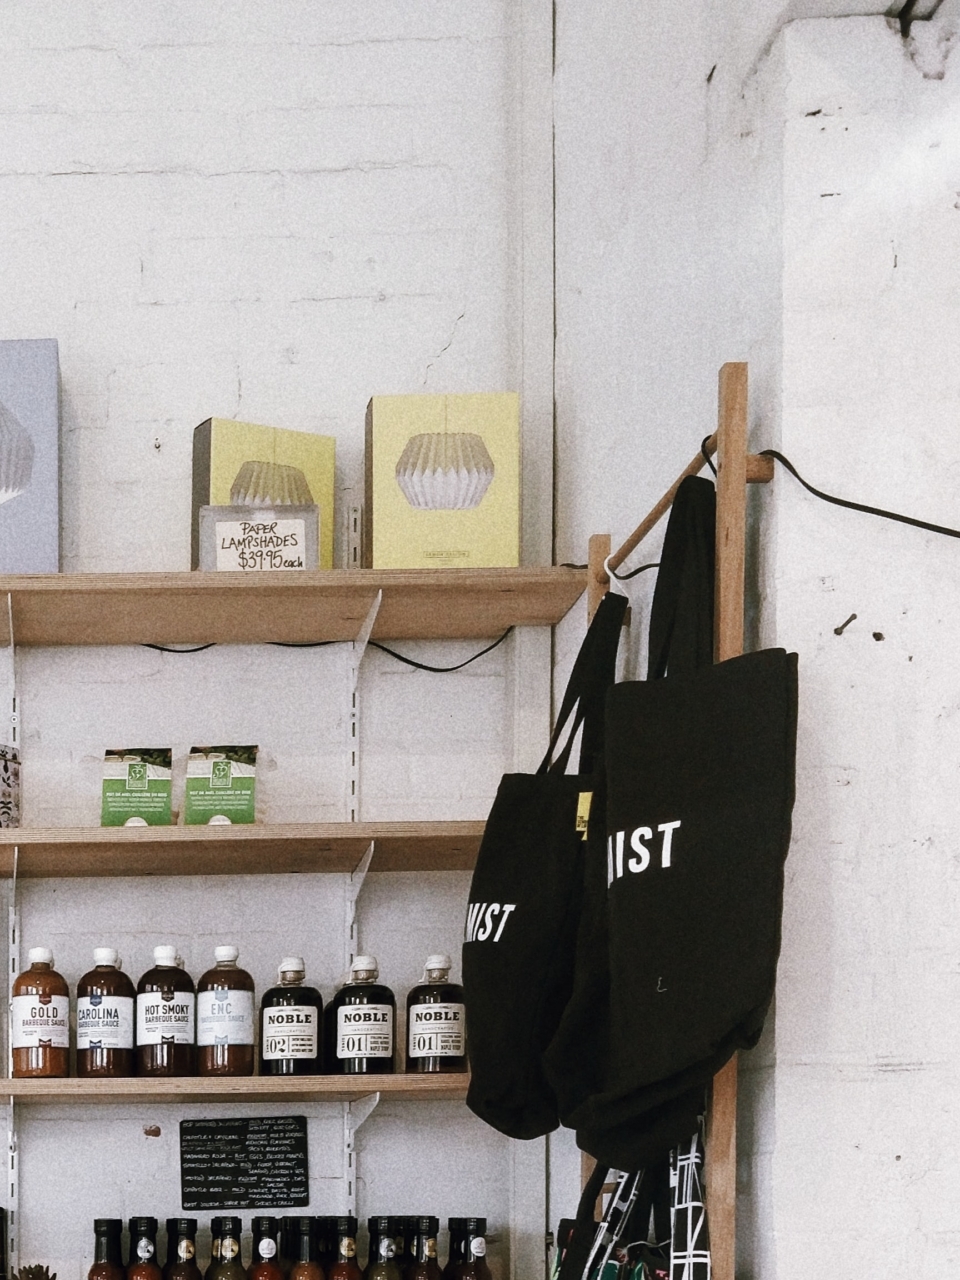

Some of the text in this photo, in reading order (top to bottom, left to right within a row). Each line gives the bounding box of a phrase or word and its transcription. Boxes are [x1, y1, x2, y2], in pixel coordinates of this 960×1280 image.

[240, 522, 279, 535] PAPER
[221, 534, 299, 551] LAMPSHADES
[283, 555, 304, 568] each
[30, 1007, 59, 1019] GOLD
[78, 1008, 119, 1020] CAROLINA
[145, 1004, 190, 1015] HOT SMOKY
[174, 1015, 189, 1023] SAUCE
[268, 1014, 312, 1024] NOBLE
[343, 1013, 388, 1023] NOBLE
[415, 1012, 460, 1022] NOBLE
[269, 1038, 286, 1053] 02
[346, 1037, 363, 1052] 01
[417, 1036, 433, 1051] 01
